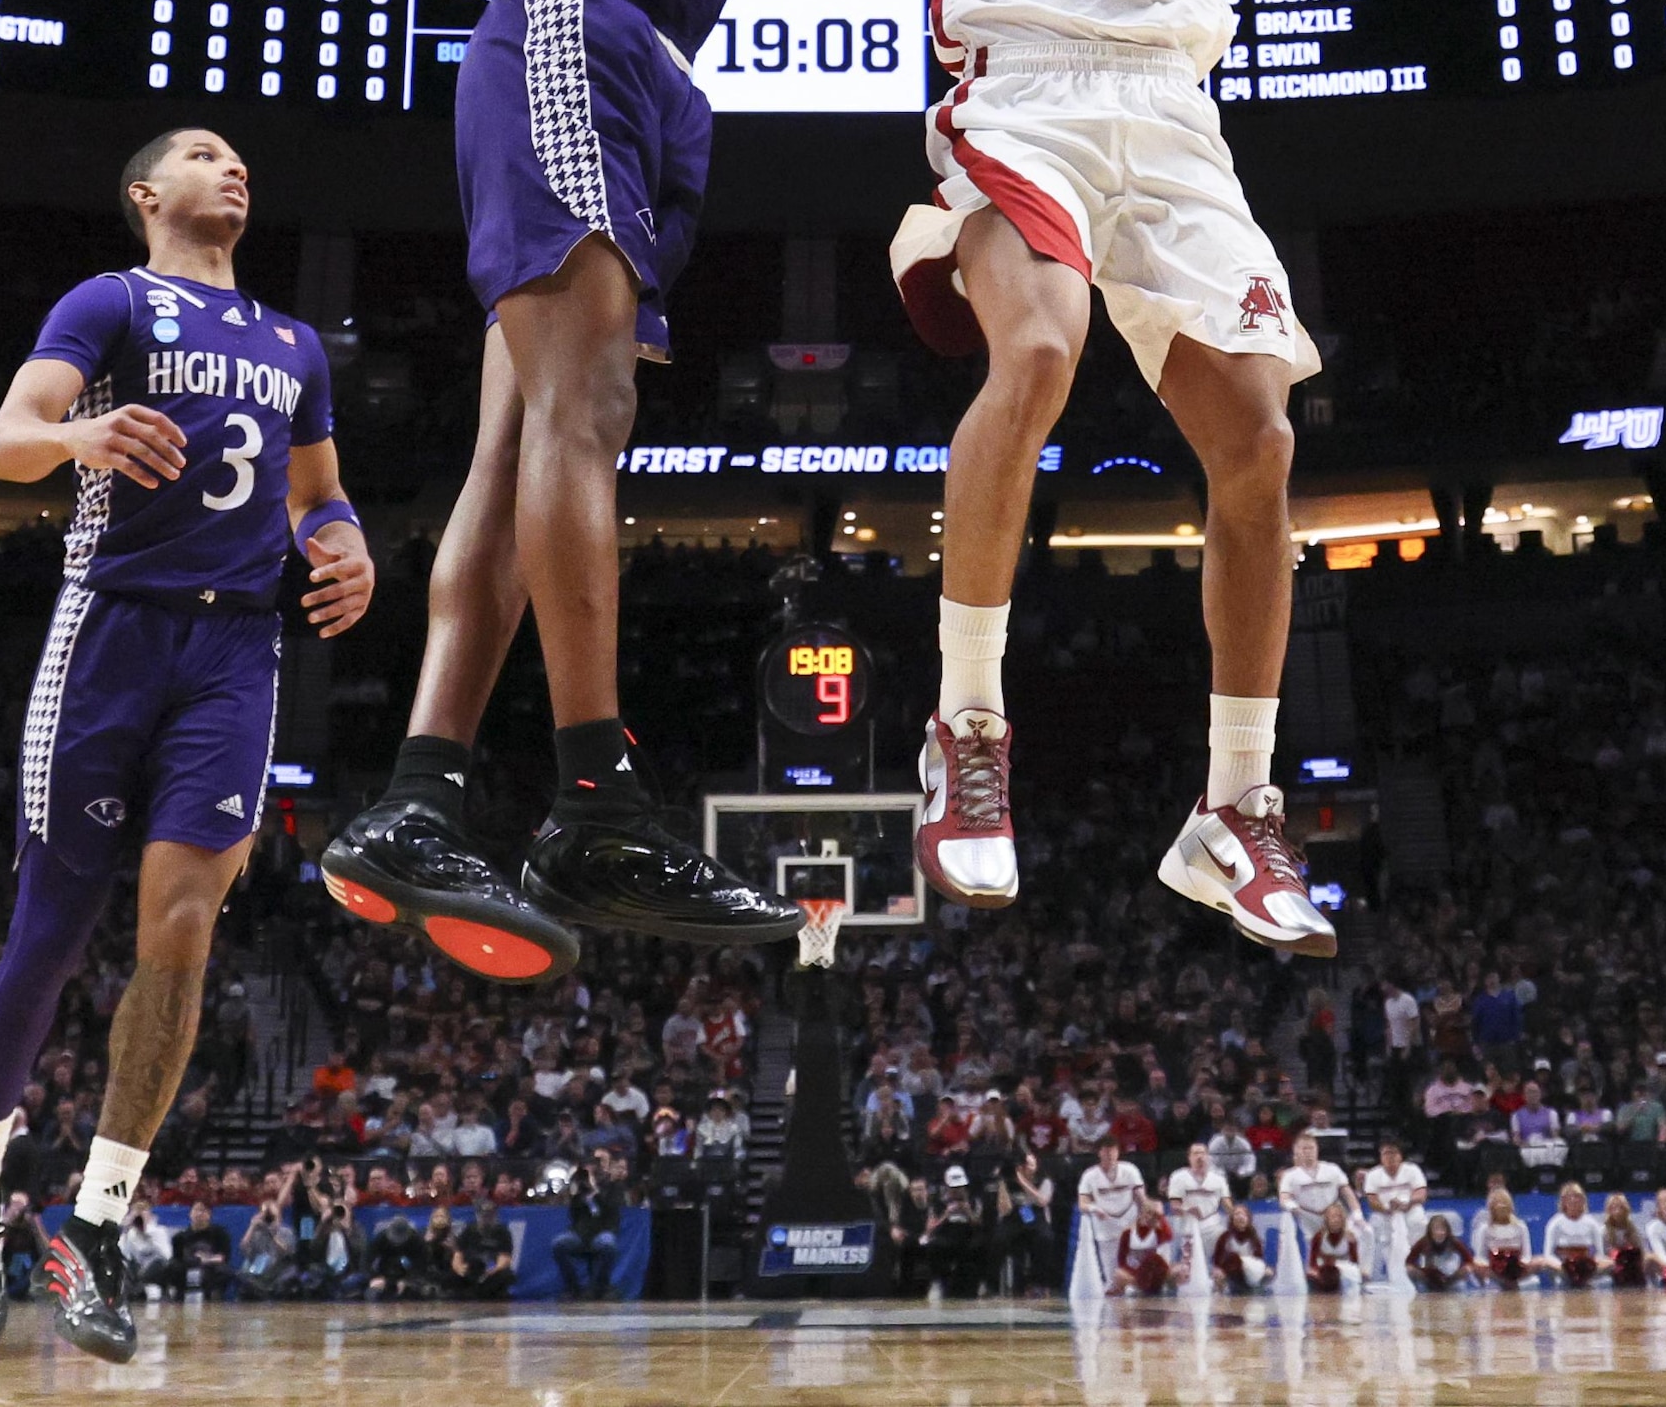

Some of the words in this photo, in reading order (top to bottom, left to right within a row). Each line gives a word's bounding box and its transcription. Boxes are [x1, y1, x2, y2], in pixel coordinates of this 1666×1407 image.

[151, 29, 171, 56] 0
[1255, 7, 1353, 36] BRAZILE
[716, 18, 900, 74] 19:08
[1221, 45, 1249, 69] 12
[1257, 42, 1321, 68] EWIN
[1500, 25, 1518, 49] 0
[149, 63, 168, 88] 0
[1220, 76, 1253, 101] 24
[1258, 68, 1387, 100] RICHMOND
[1390, 66, 1426, 90] III
[1502, 57, 1521, 82] 0
[148, 351, 227, 397] HIGH
[236, 358, 302, 422] POINT
[202, 413, 263, 511] 3
[630, 446, 728, 473] FIRST
[760, 446, 888, 473] SECOND
[894, 446, 950, 472] ROU
[789, 646, 853, 676] 19:08
[817, 675, 850, 725] 9
